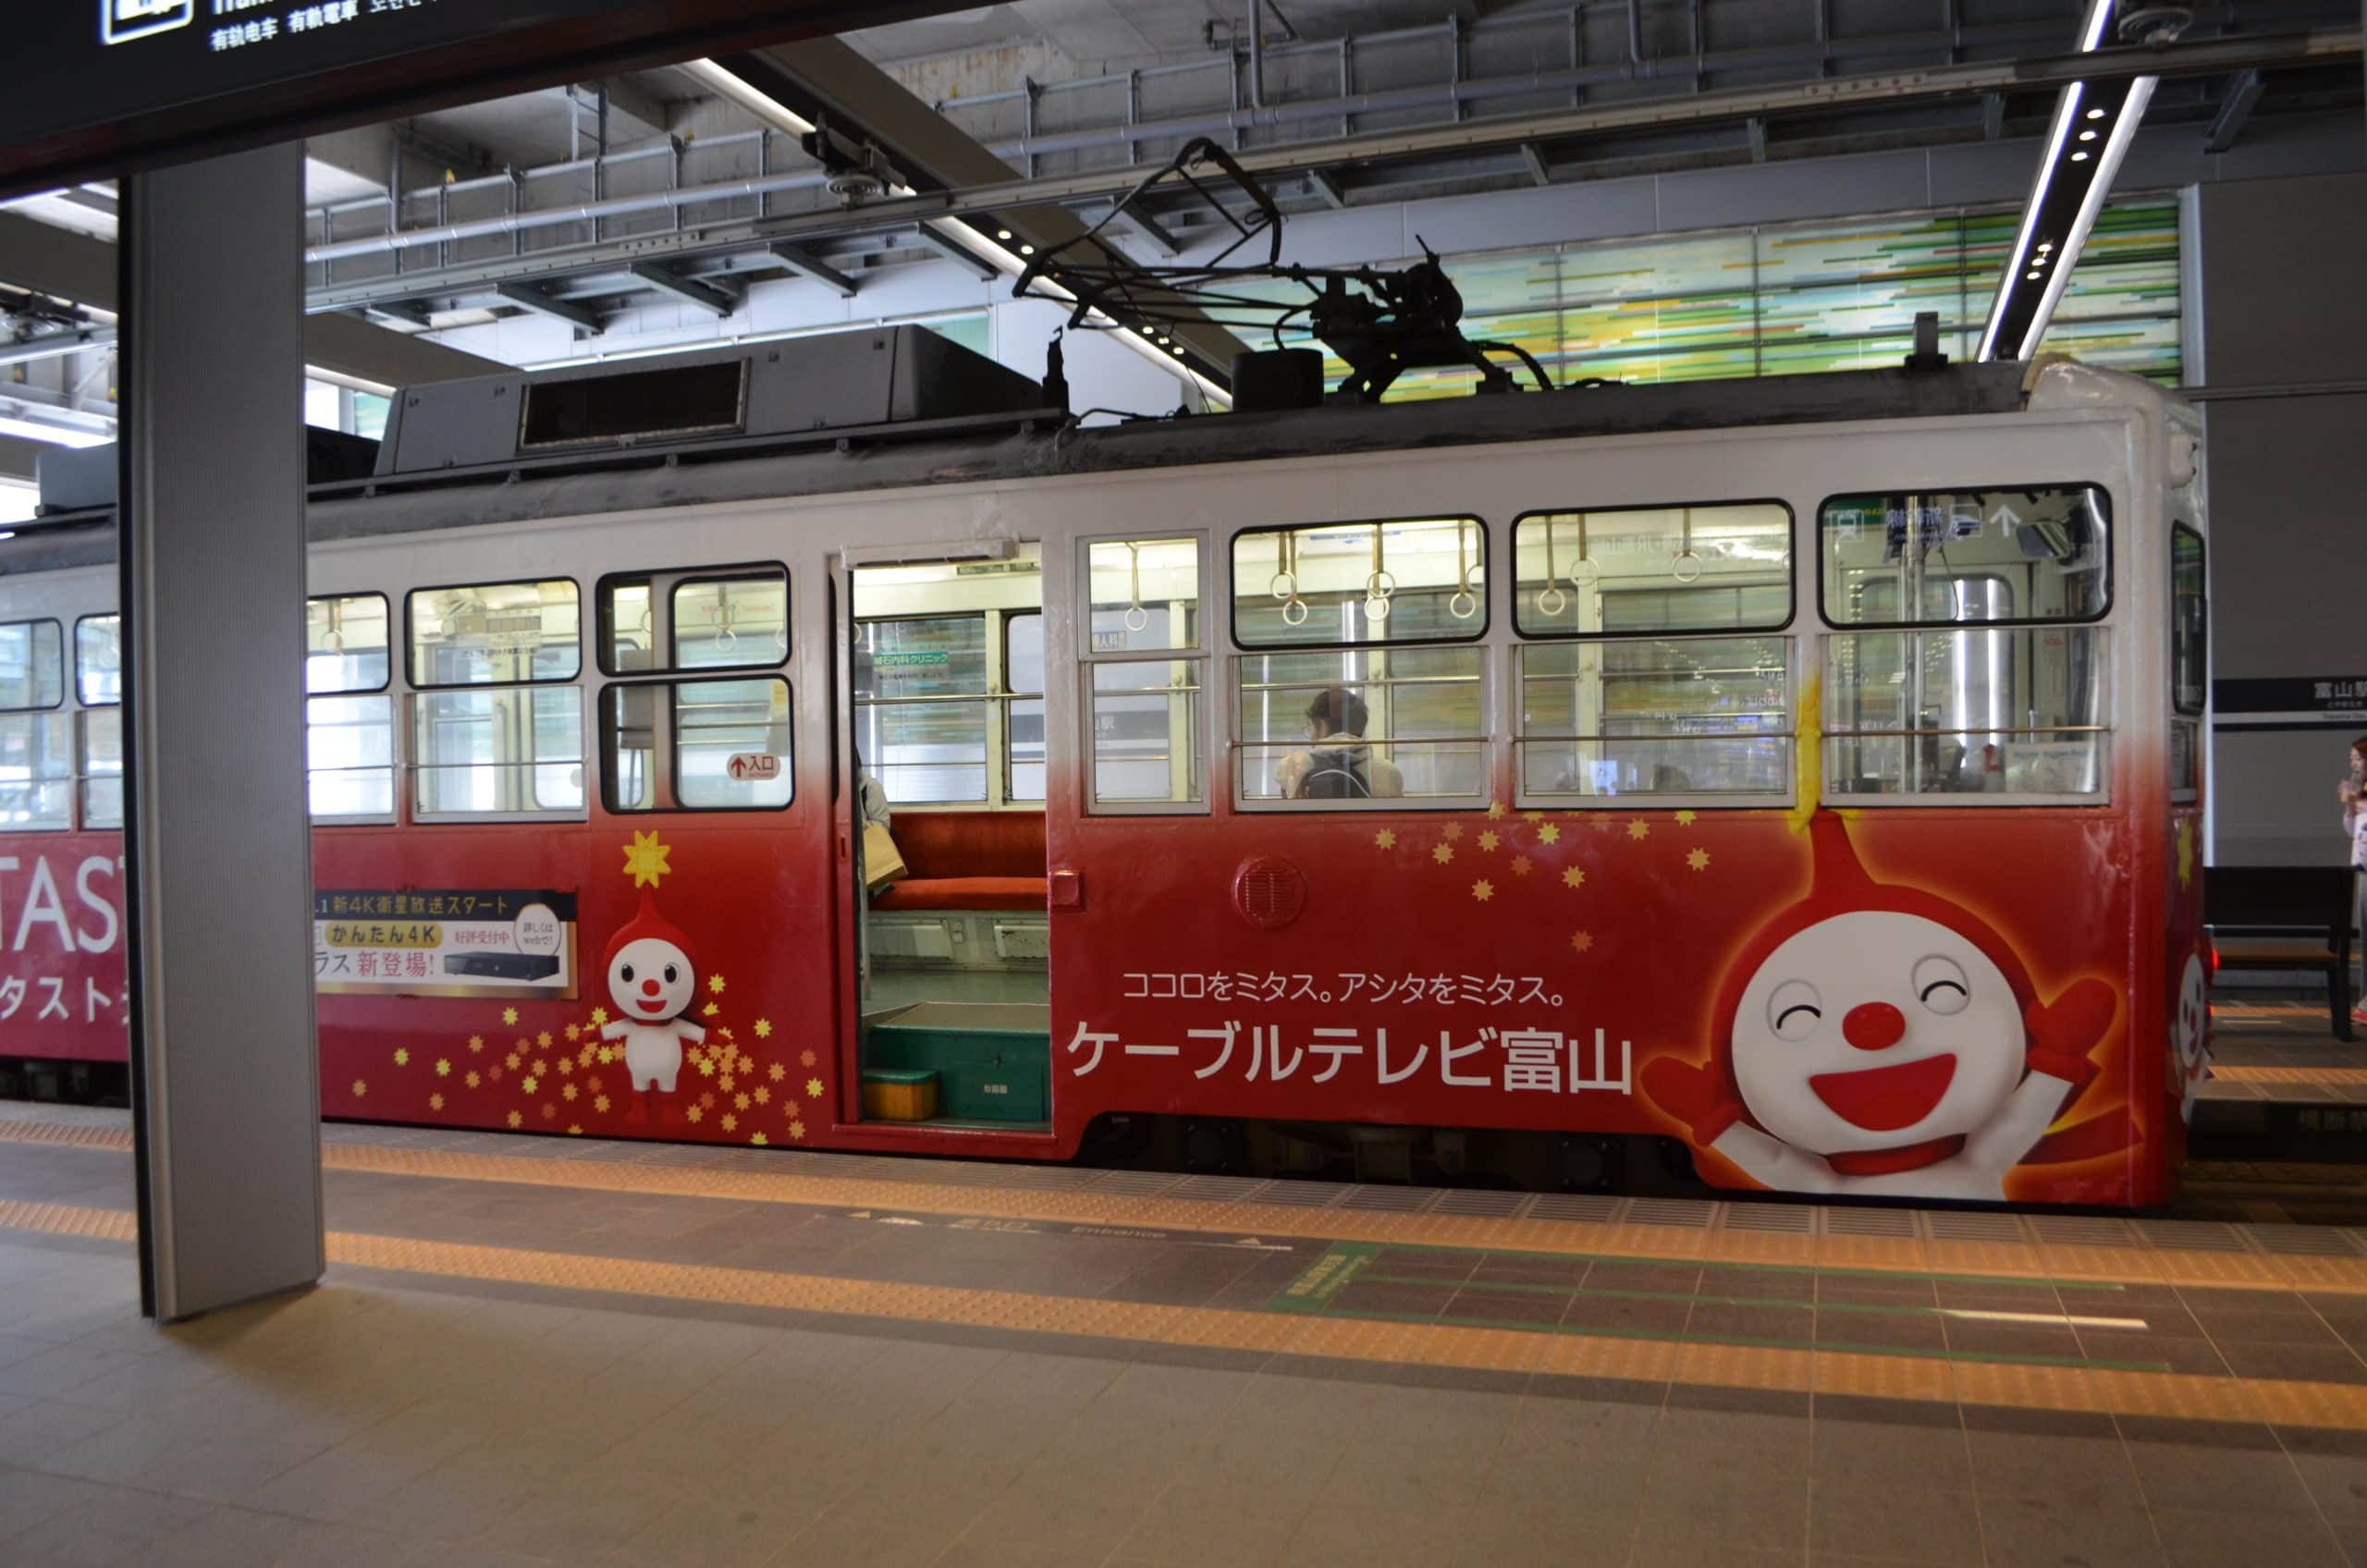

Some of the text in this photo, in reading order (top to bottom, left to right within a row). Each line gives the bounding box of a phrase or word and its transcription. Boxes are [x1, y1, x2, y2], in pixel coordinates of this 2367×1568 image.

[749, 755, 774, 770] 入口
[0, 856, 125, 952] AS
[333, 895, 509, 915] 新4K衛星放送スタート
[332, 925, 436, 944] かんたん4K
[0, 975, 129, 1023] タスト
[1067, 1020, 1632, 1095] ケーブルテレビ富山
